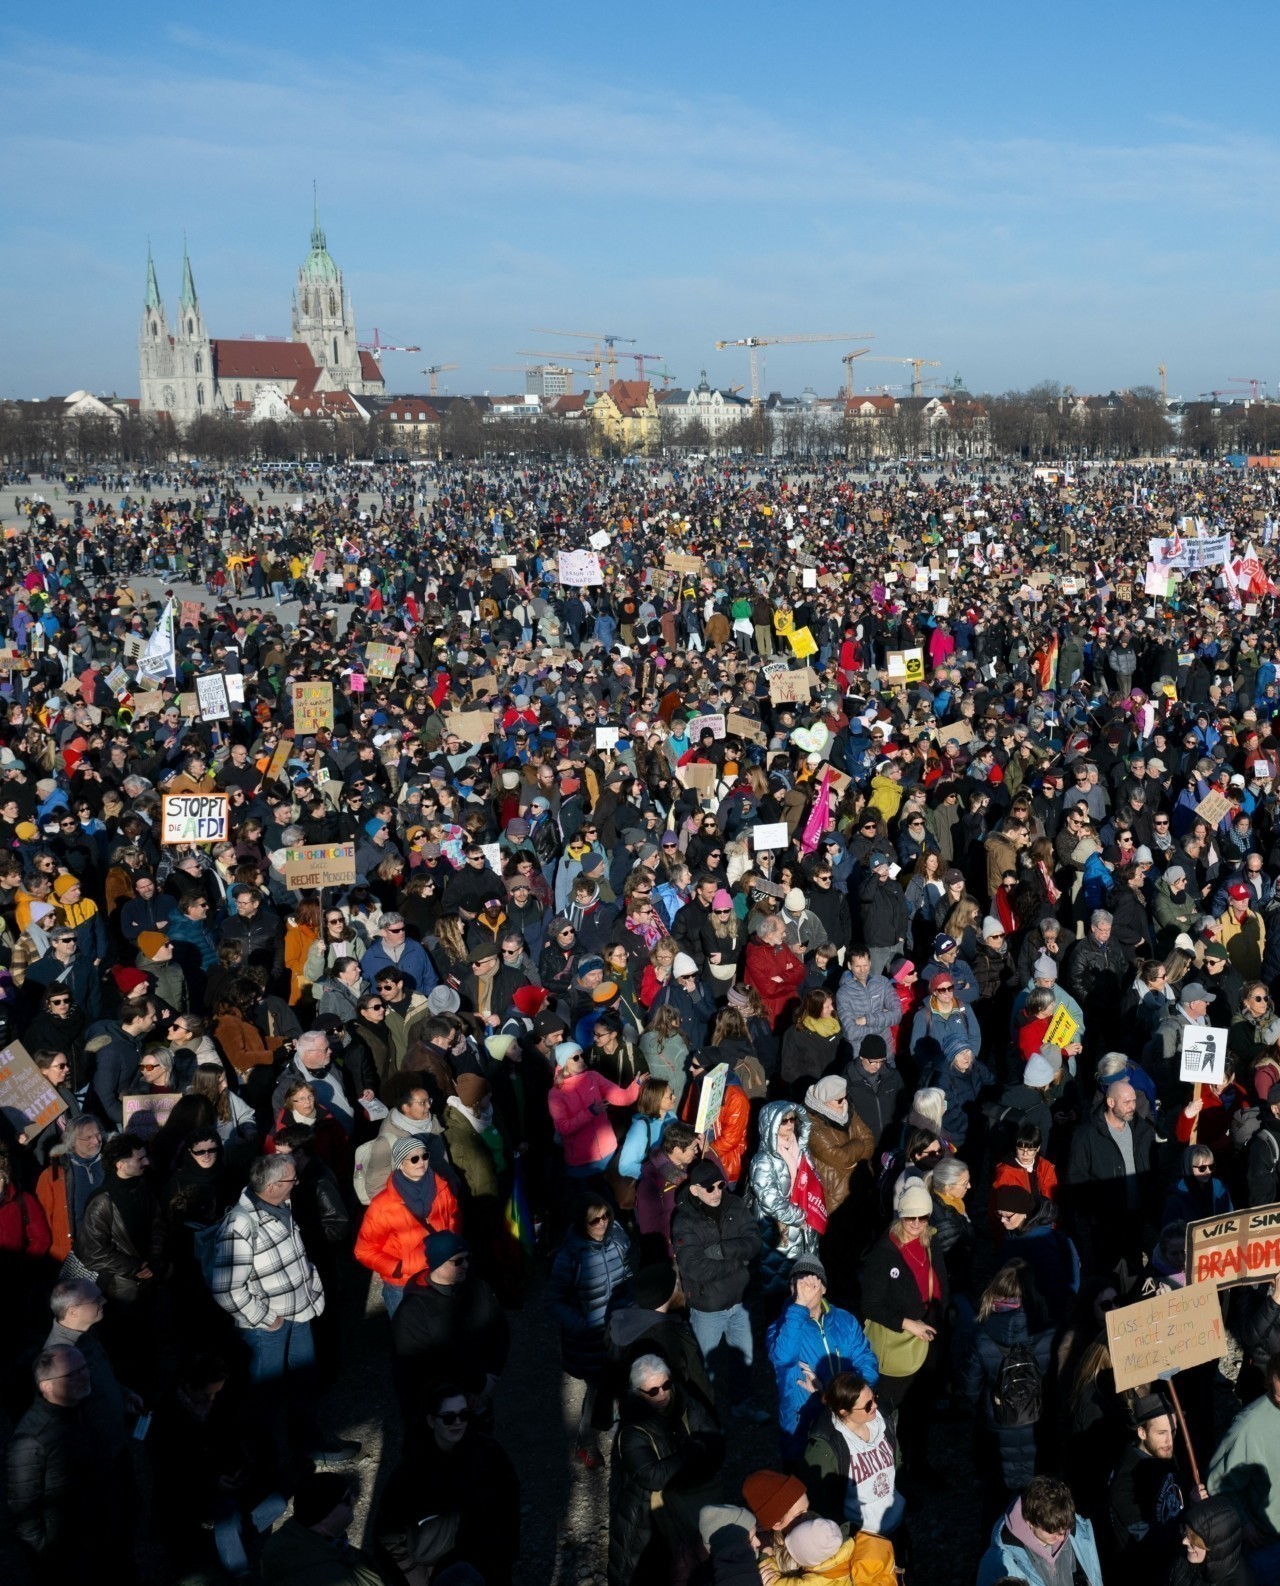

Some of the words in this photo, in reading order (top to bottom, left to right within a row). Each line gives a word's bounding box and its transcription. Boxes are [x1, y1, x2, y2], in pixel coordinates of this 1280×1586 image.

[295, 687, 331, 699] BUNT
[166, 797, 227, 818] STOPPT
[182, 817, 225, 838] AFD!
[286, 846, 354, 861] MENSCHENRECHTE
[290, 873, 321, 886] RECHTE
[323, 871, 355, 883] MENSCHEN
[808, 1190, 828, 1218] aritas
[1202, 1220, 1238, 1239] WIR
[1146, 1302, 1165, 1325] den
[1168, 1292, 1214, 1318] Februar
[1134, 1323, 1163, 1348] nicht
[1167, 1320, 1195, 1337] zum
[1124, 1350, 1161, 1373] Merz
[1168, 1318, 1221, 1356] werden!
